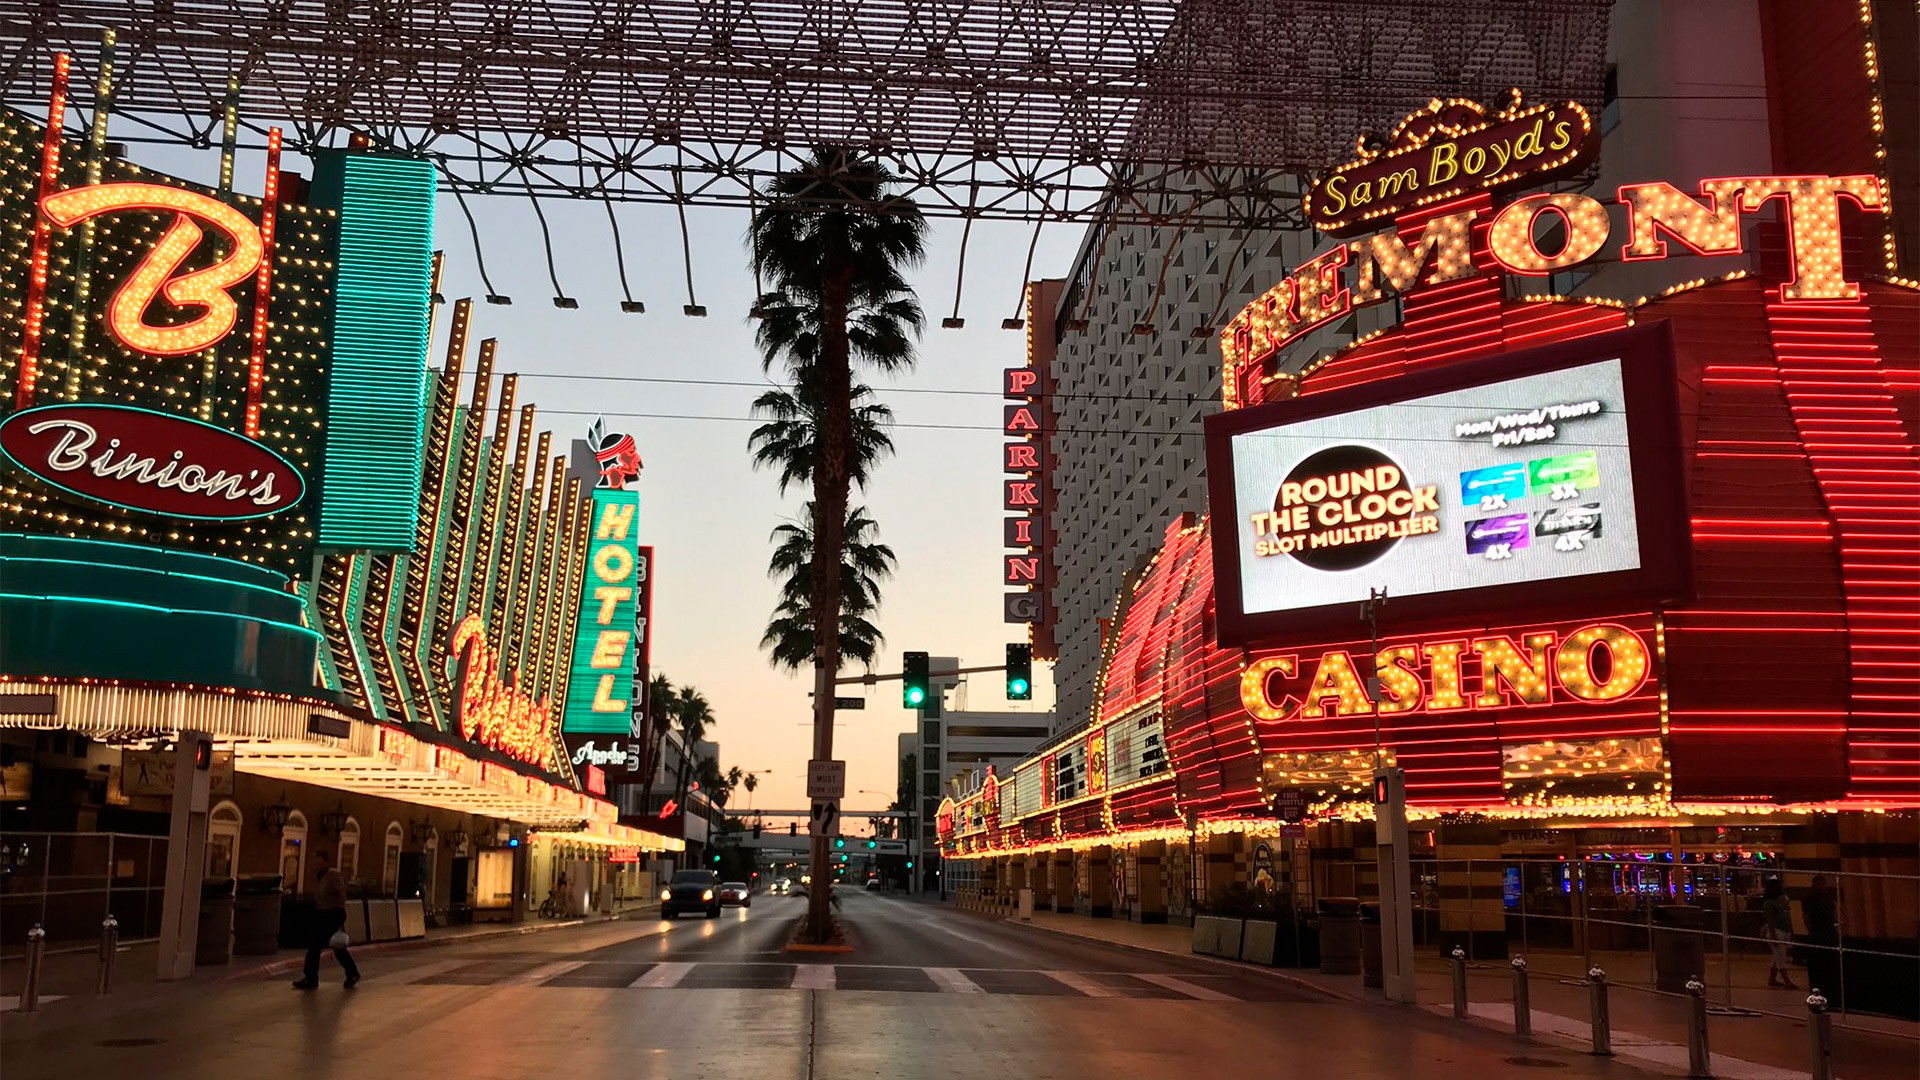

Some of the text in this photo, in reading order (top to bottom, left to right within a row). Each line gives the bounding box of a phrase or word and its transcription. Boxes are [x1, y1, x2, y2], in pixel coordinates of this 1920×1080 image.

[1322, 110, 1573, 217] Sam Boyd's
[41, 183, 264, 356] B
[1221, 174, 1885, 411] FREMONT
[1455, 400, 1601, 439] Mon/Wed/Thurs
[1492, 424, 1556, 448] Fri/Sat
[28, 419, 281, 507] Binion's
[1008, 371, 1038, 619] PARKING
[1281, 464, 1402, 508] ROUND
[1480, 493, 1508, 512] 2X
[1550, 483, 1579, 502] 3X
[1251, 485, 1439, 538] THE CLOCK
[1255, 515, 1439, 557] SLOT MULTIPLIER
[1485, 542, 1513, 561] 4X
[1554, 533, 1585, 552] 4X
[591, 503, 636, 714] HOTEL
[1239, 624, 1652, 723] CASINO
[571, 740, 627, 765] Apache
